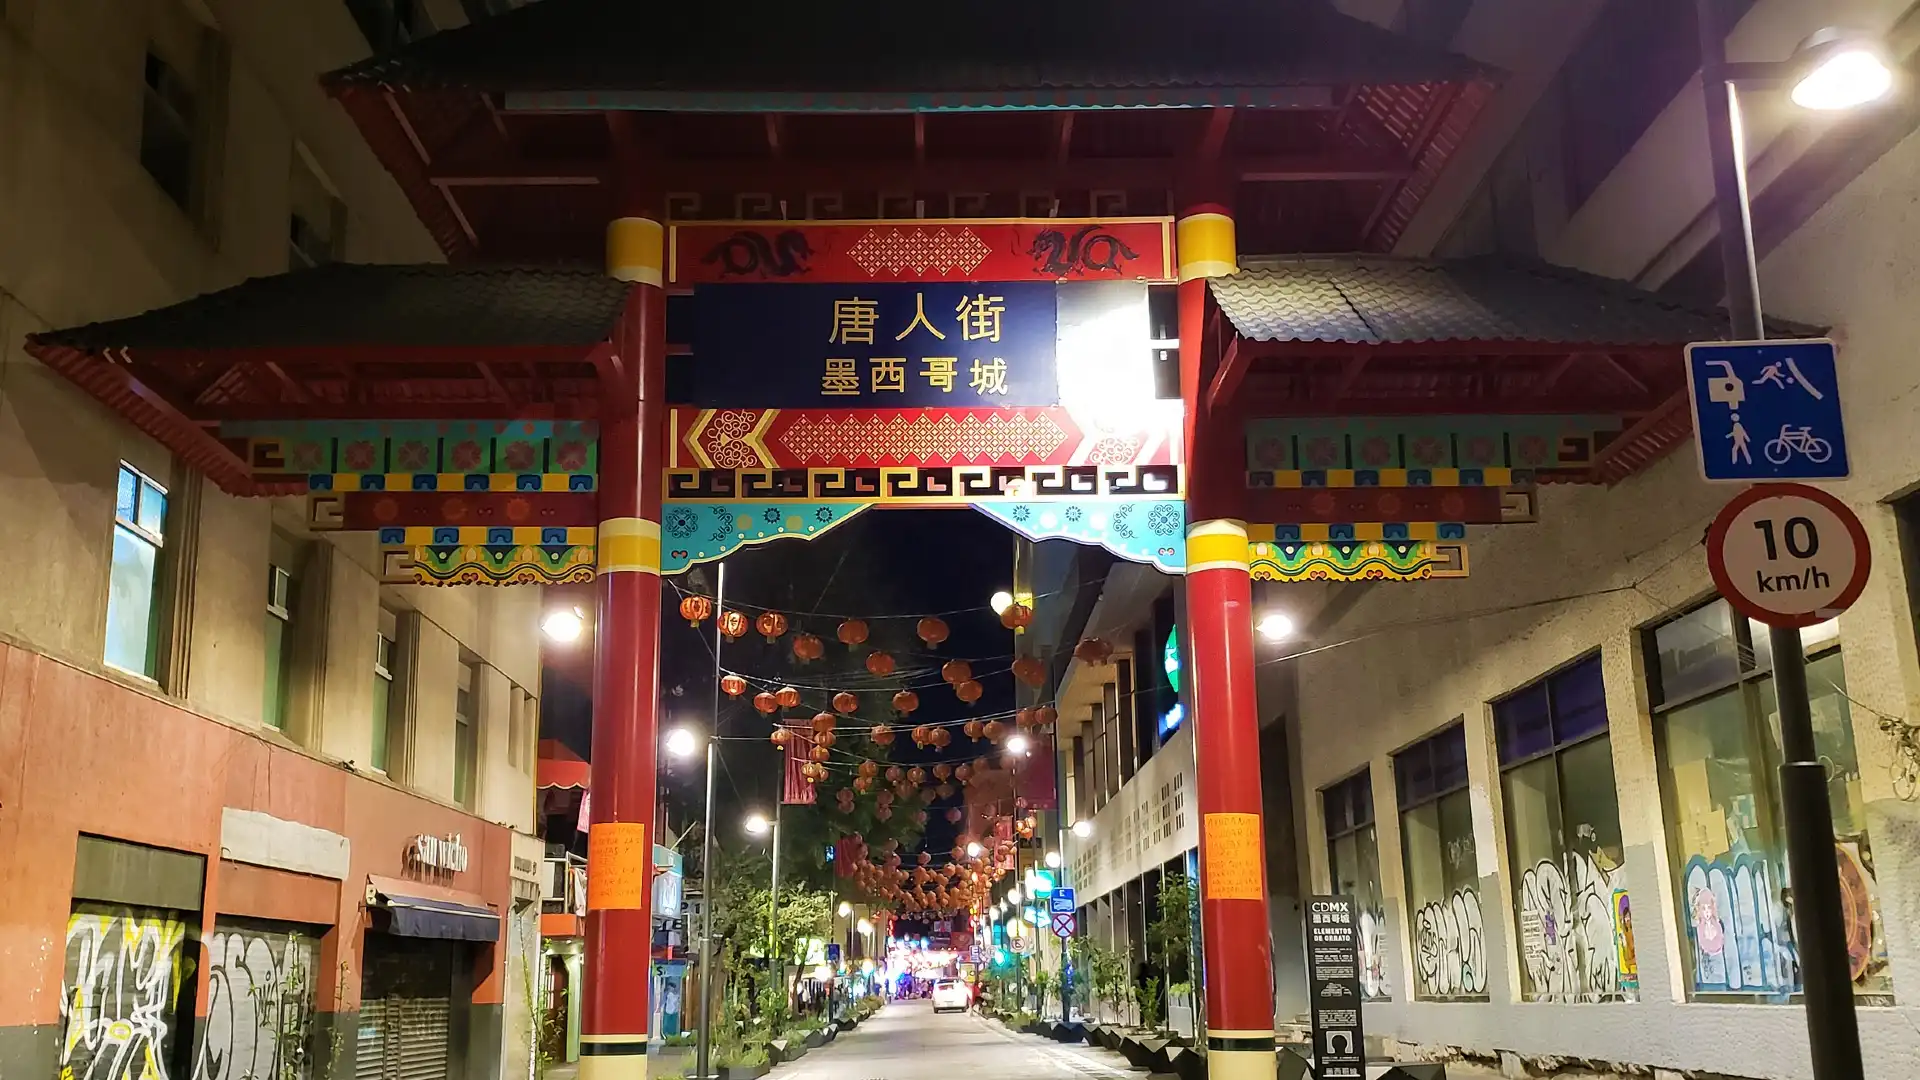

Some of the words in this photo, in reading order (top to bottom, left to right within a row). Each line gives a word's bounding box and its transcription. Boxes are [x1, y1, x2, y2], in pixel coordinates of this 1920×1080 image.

[828, 291, 1006, 344] 唐人街
[820, 356, 1009, 396] 墨西哥城
[1754, 516, 1820, 561] 10
[1757, 565, 1830, 593] km/h
[1059, 889, 1065, 897] E
[1312, 902, 1349, 912] CDMX
